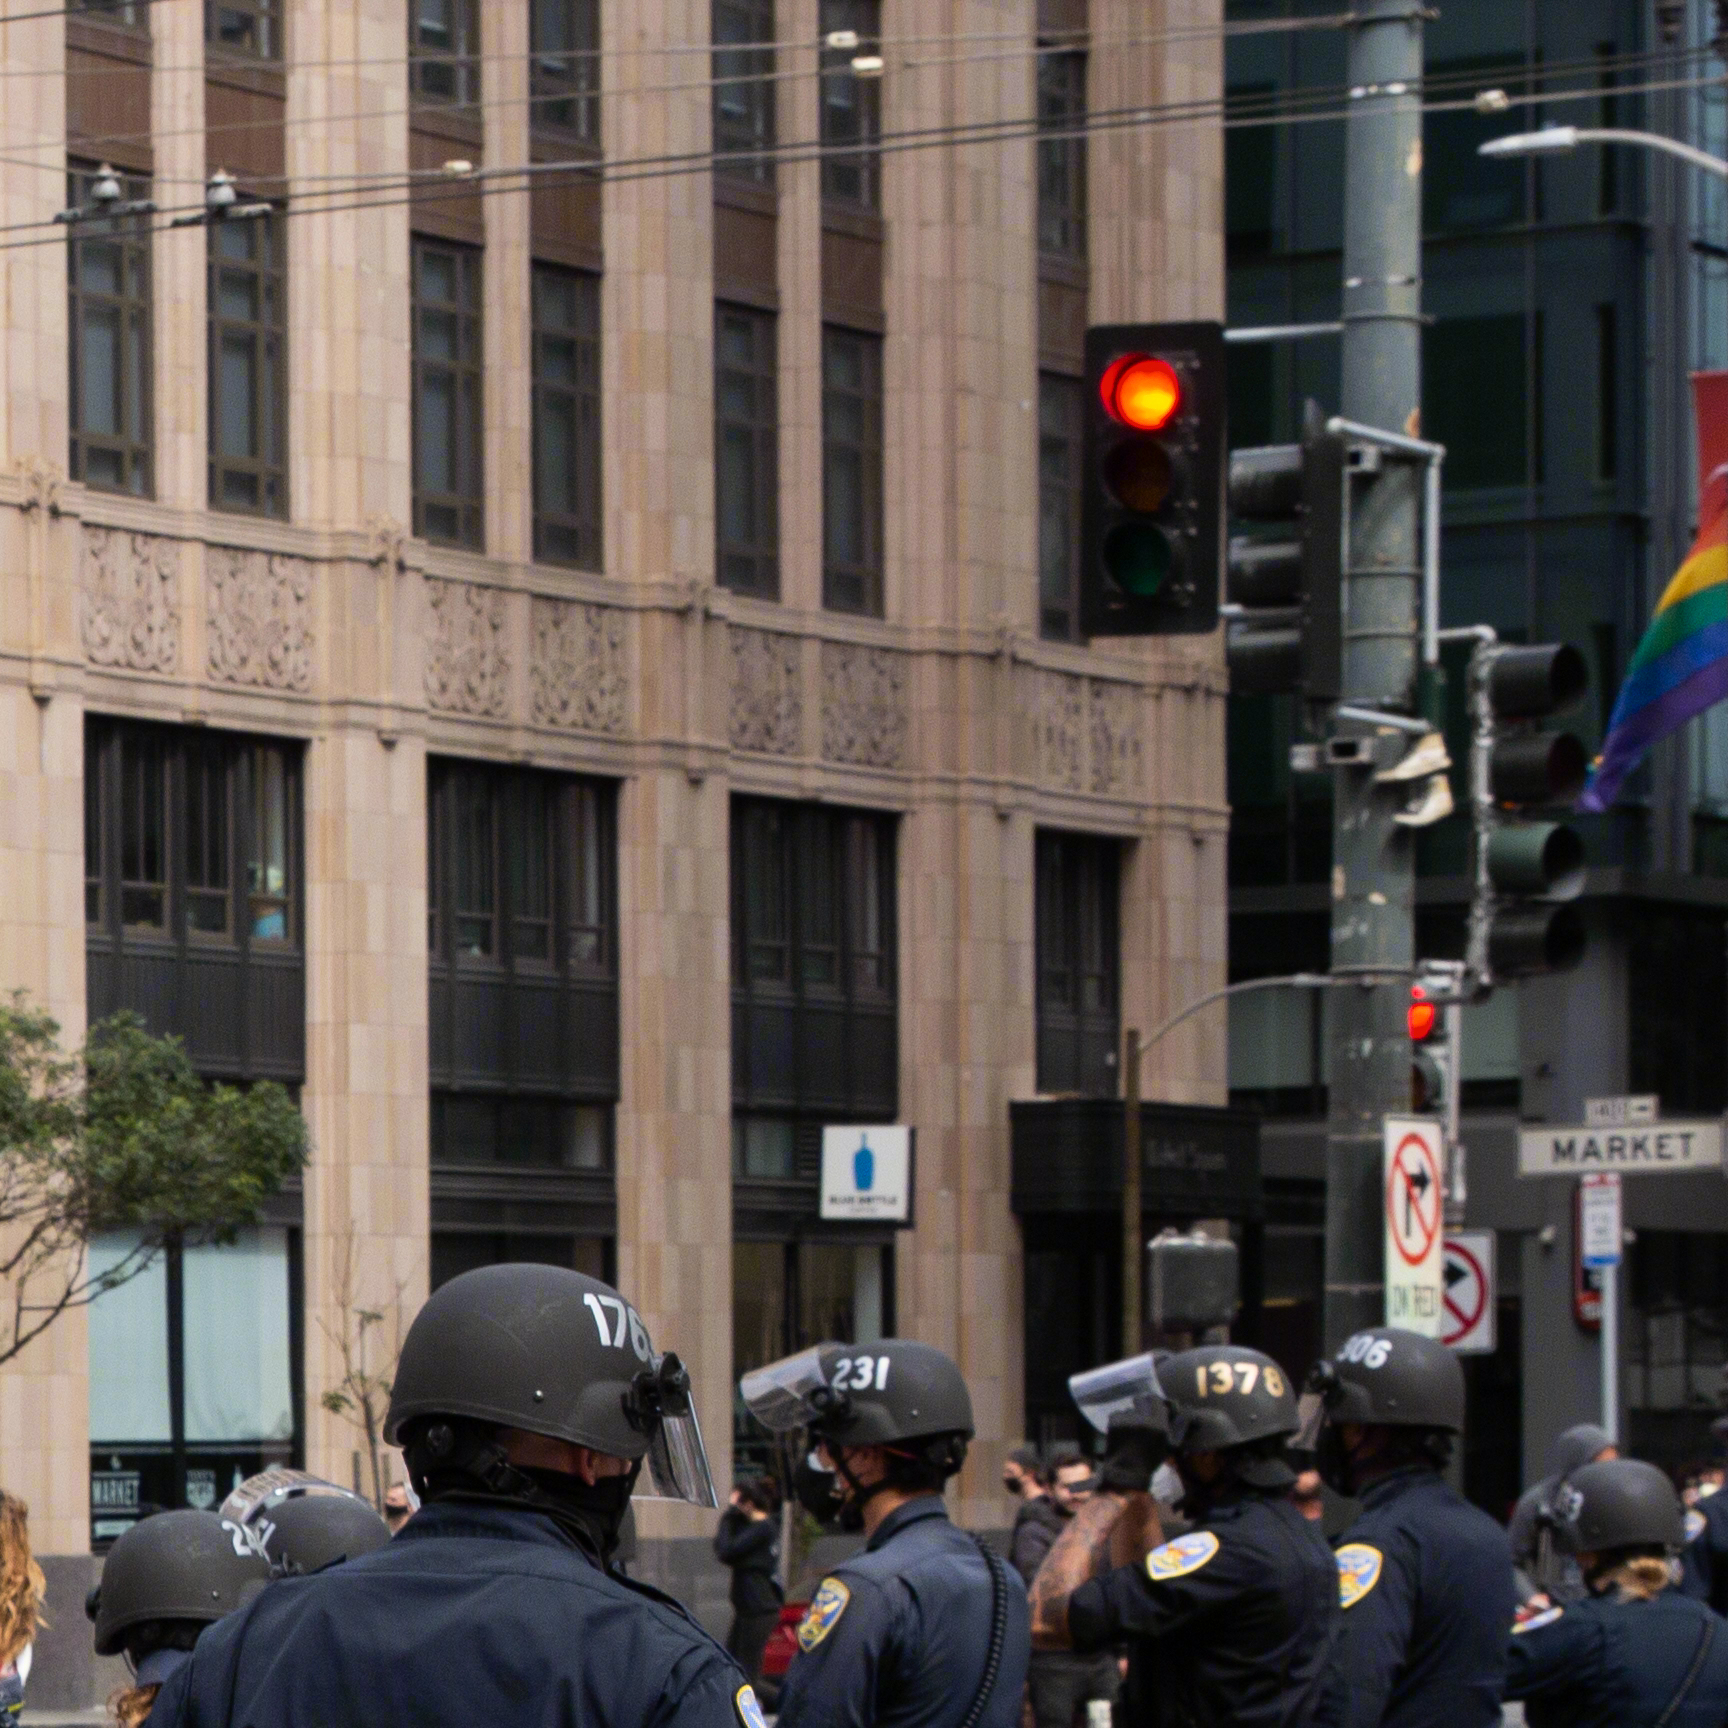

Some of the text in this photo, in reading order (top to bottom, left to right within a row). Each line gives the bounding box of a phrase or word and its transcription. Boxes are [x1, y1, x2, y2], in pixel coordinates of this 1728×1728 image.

[1552, 1133, 1694, 1163] MARKET
[831, 1356, 891, 1391] 231
[1197, 1361, 1284, 1398] 1378
